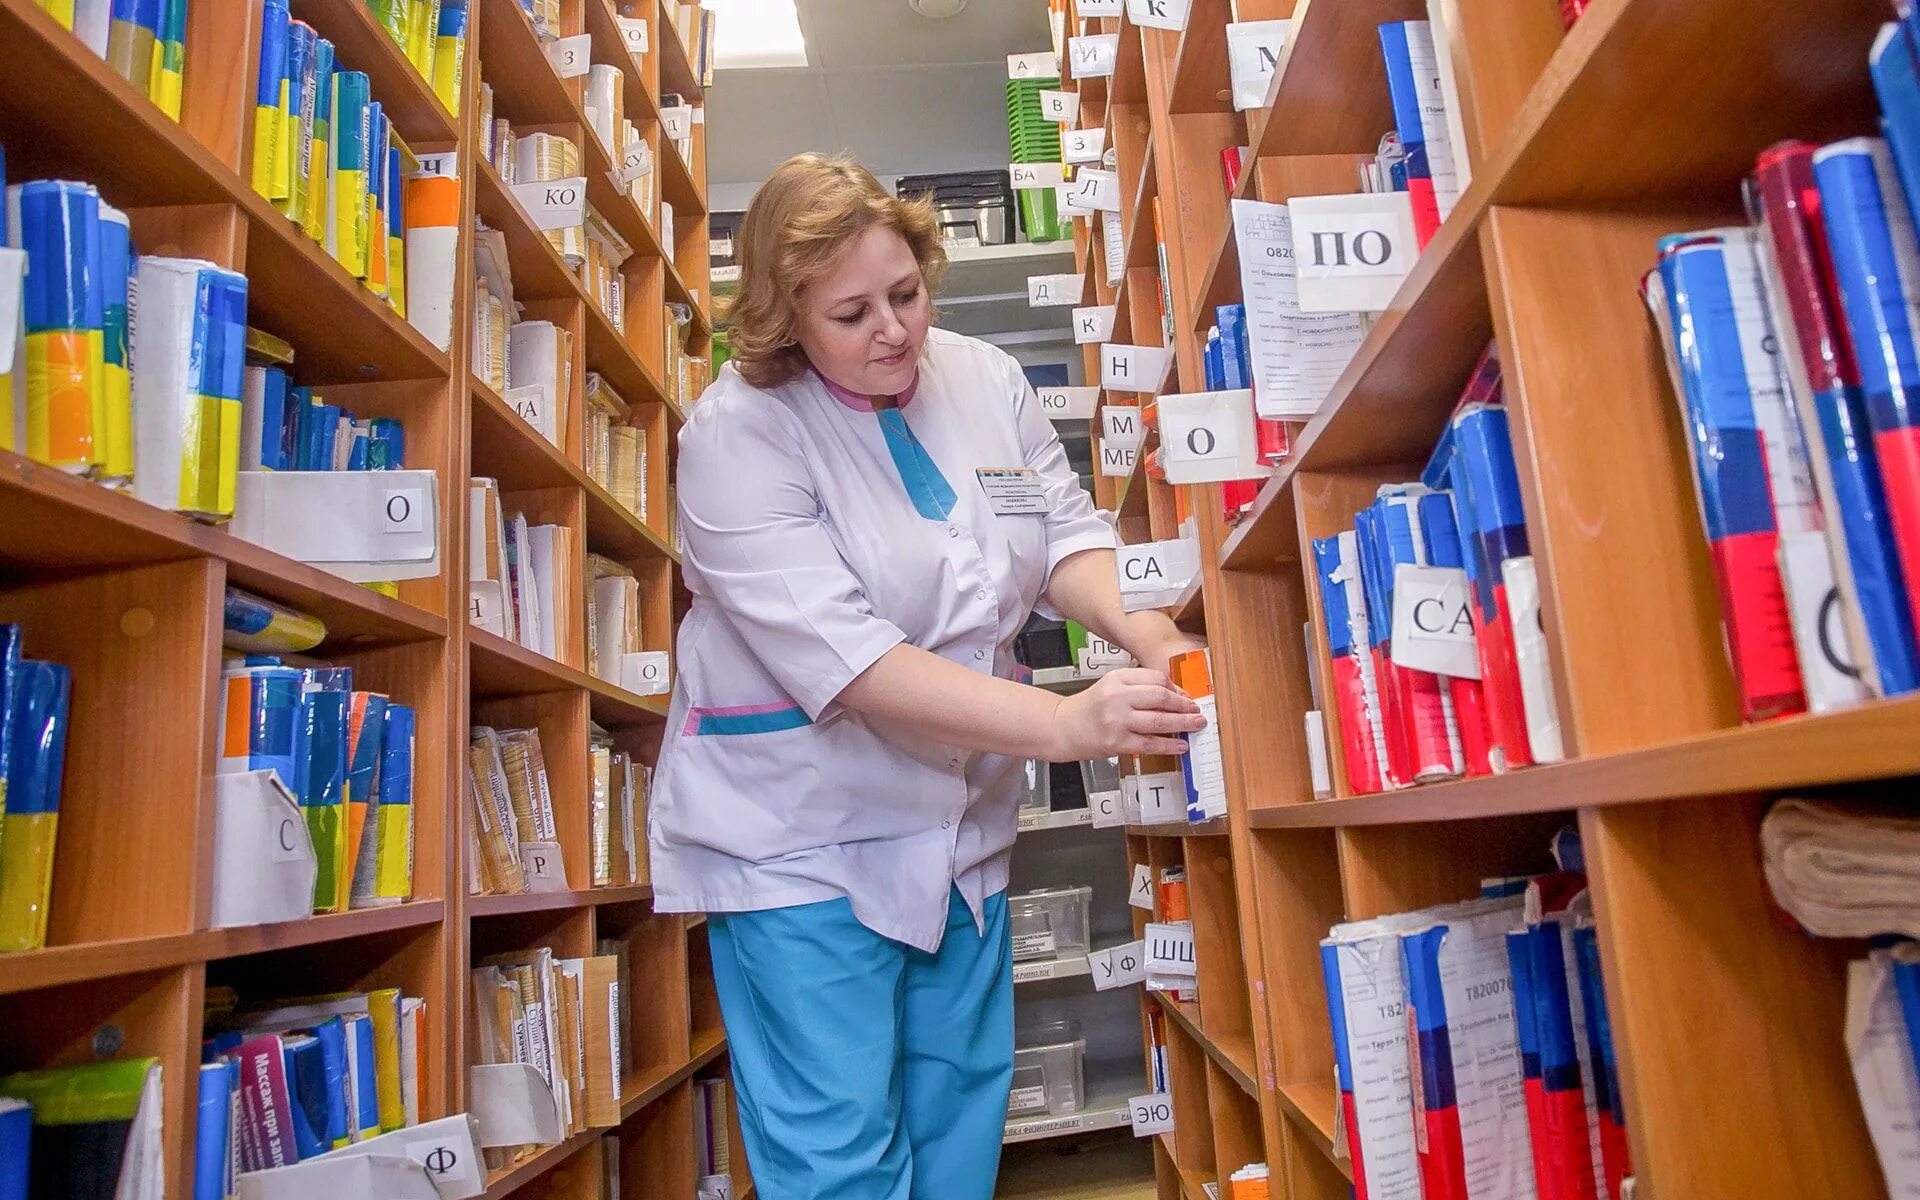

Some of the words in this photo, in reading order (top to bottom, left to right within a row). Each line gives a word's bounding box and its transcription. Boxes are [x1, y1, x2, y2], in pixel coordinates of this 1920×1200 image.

[1016, 60, 1029, 71] А
[1052, 99, 1063, 112] В
[1014, 168, 1036, 181] БА
[1080, 179, 1098, 196] Л
[543, 188, 576, 206] КО
[1309, 230, 1392, 267] ПО
[1035, 284, 1050, 301] Д
[1083, 318, 1096, 333] К
[1112, 356, 1128, 378] Н
[1042, 394, 1067, 409] КО
[1112, 416, 1134, 434] М
[1186, 427, 1216, 456] О
[386, 495, 410, 523] О
[1125, 556, 1163, 581] СА
[1413, 598, 1476, 636] СА
[642, 664, 658, 680] О
[1148, 786, 1165, 808] Т
[1100, 799, 1113, 815] С
[279, 818, 296, 852] С
[534, 856, 546, 874] Р
[1138, 877, 1151, 895] Х
[1101, 960, 1113, 978] У
[1120, 954, 1136, 971] Ф
[254, 1052, 273, 1110] Массаж
[1136, 1104, 1170, 1123] ЭЮ
[262, 1108, 279, 1138] при
[425, 1145, 457, 1175] Ф
